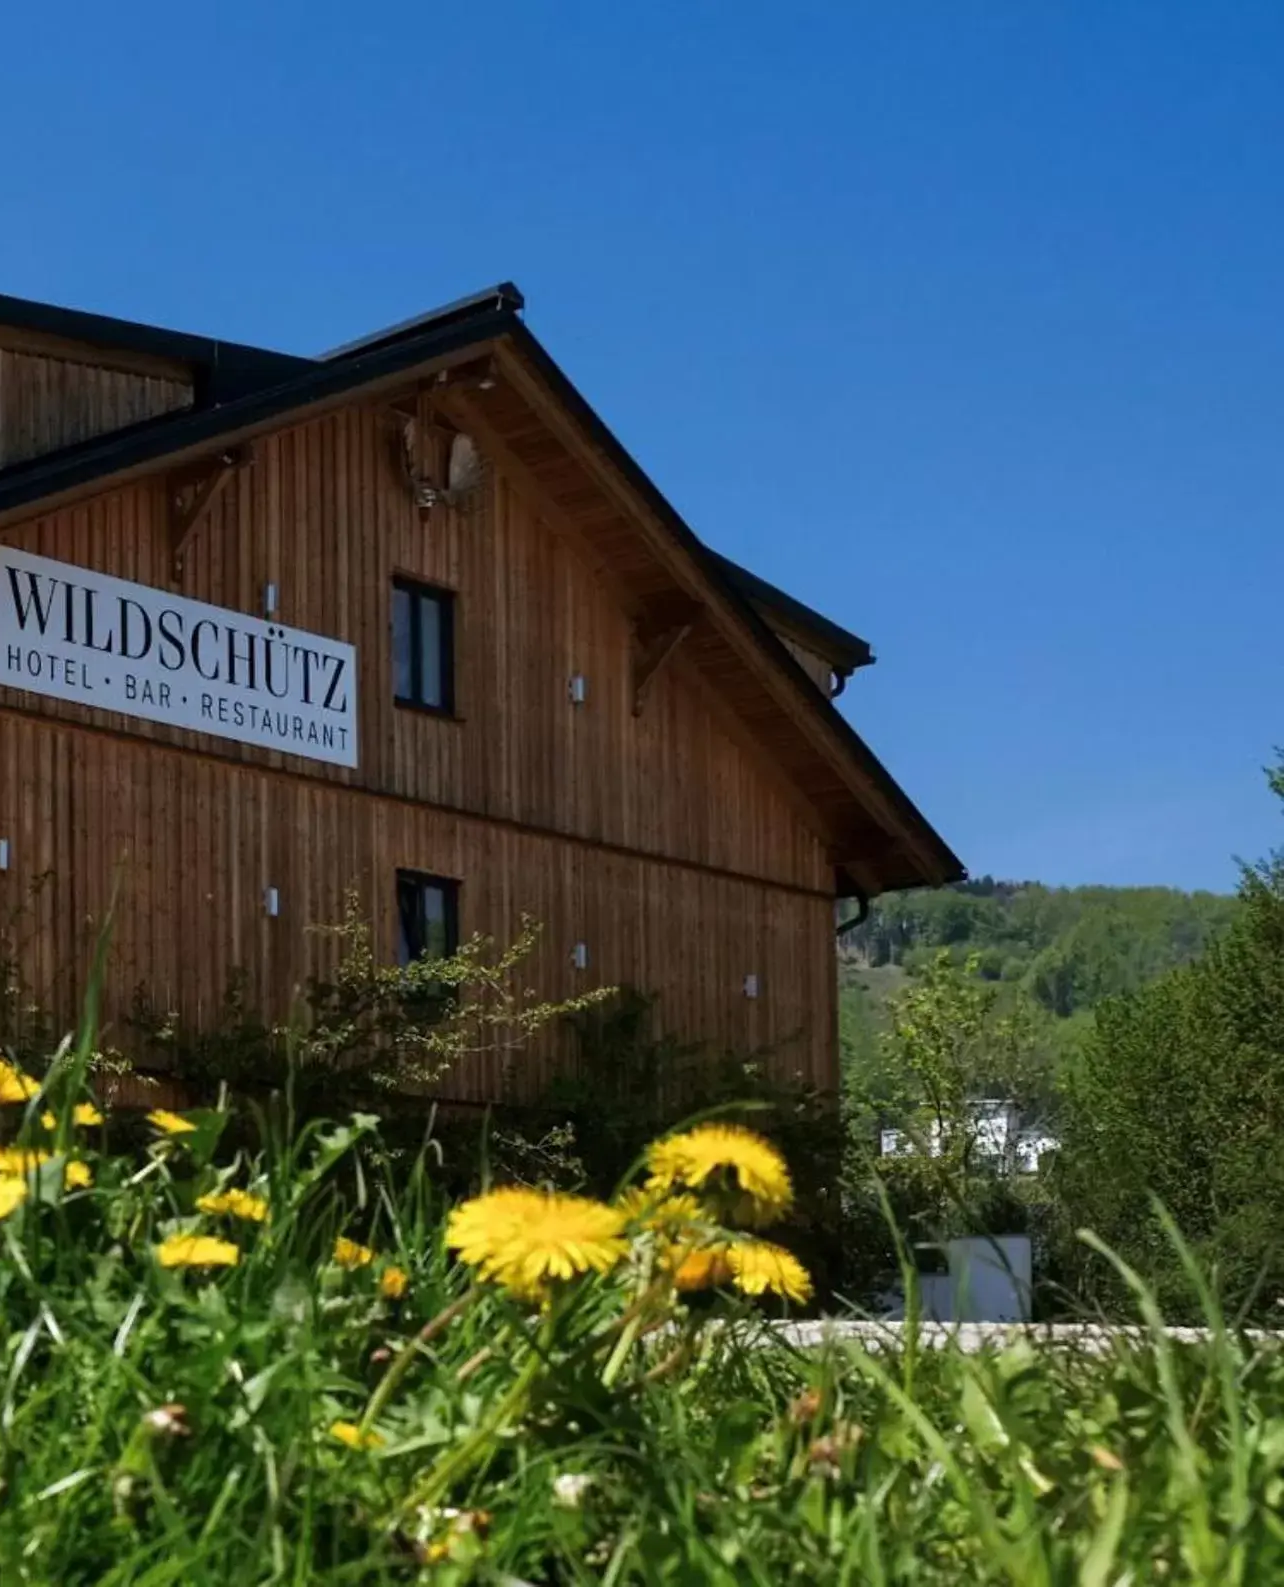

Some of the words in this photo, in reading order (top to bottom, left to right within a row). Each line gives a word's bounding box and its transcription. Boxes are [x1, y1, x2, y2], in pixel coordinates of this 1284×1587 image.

[5, 566, 347, 713] WILDSCHÜTZ
[7, 645, 92, 690] HOTEL
[125, 674, 171, 709] BAR
[202, 694, 348, 751] RESTAURANT
